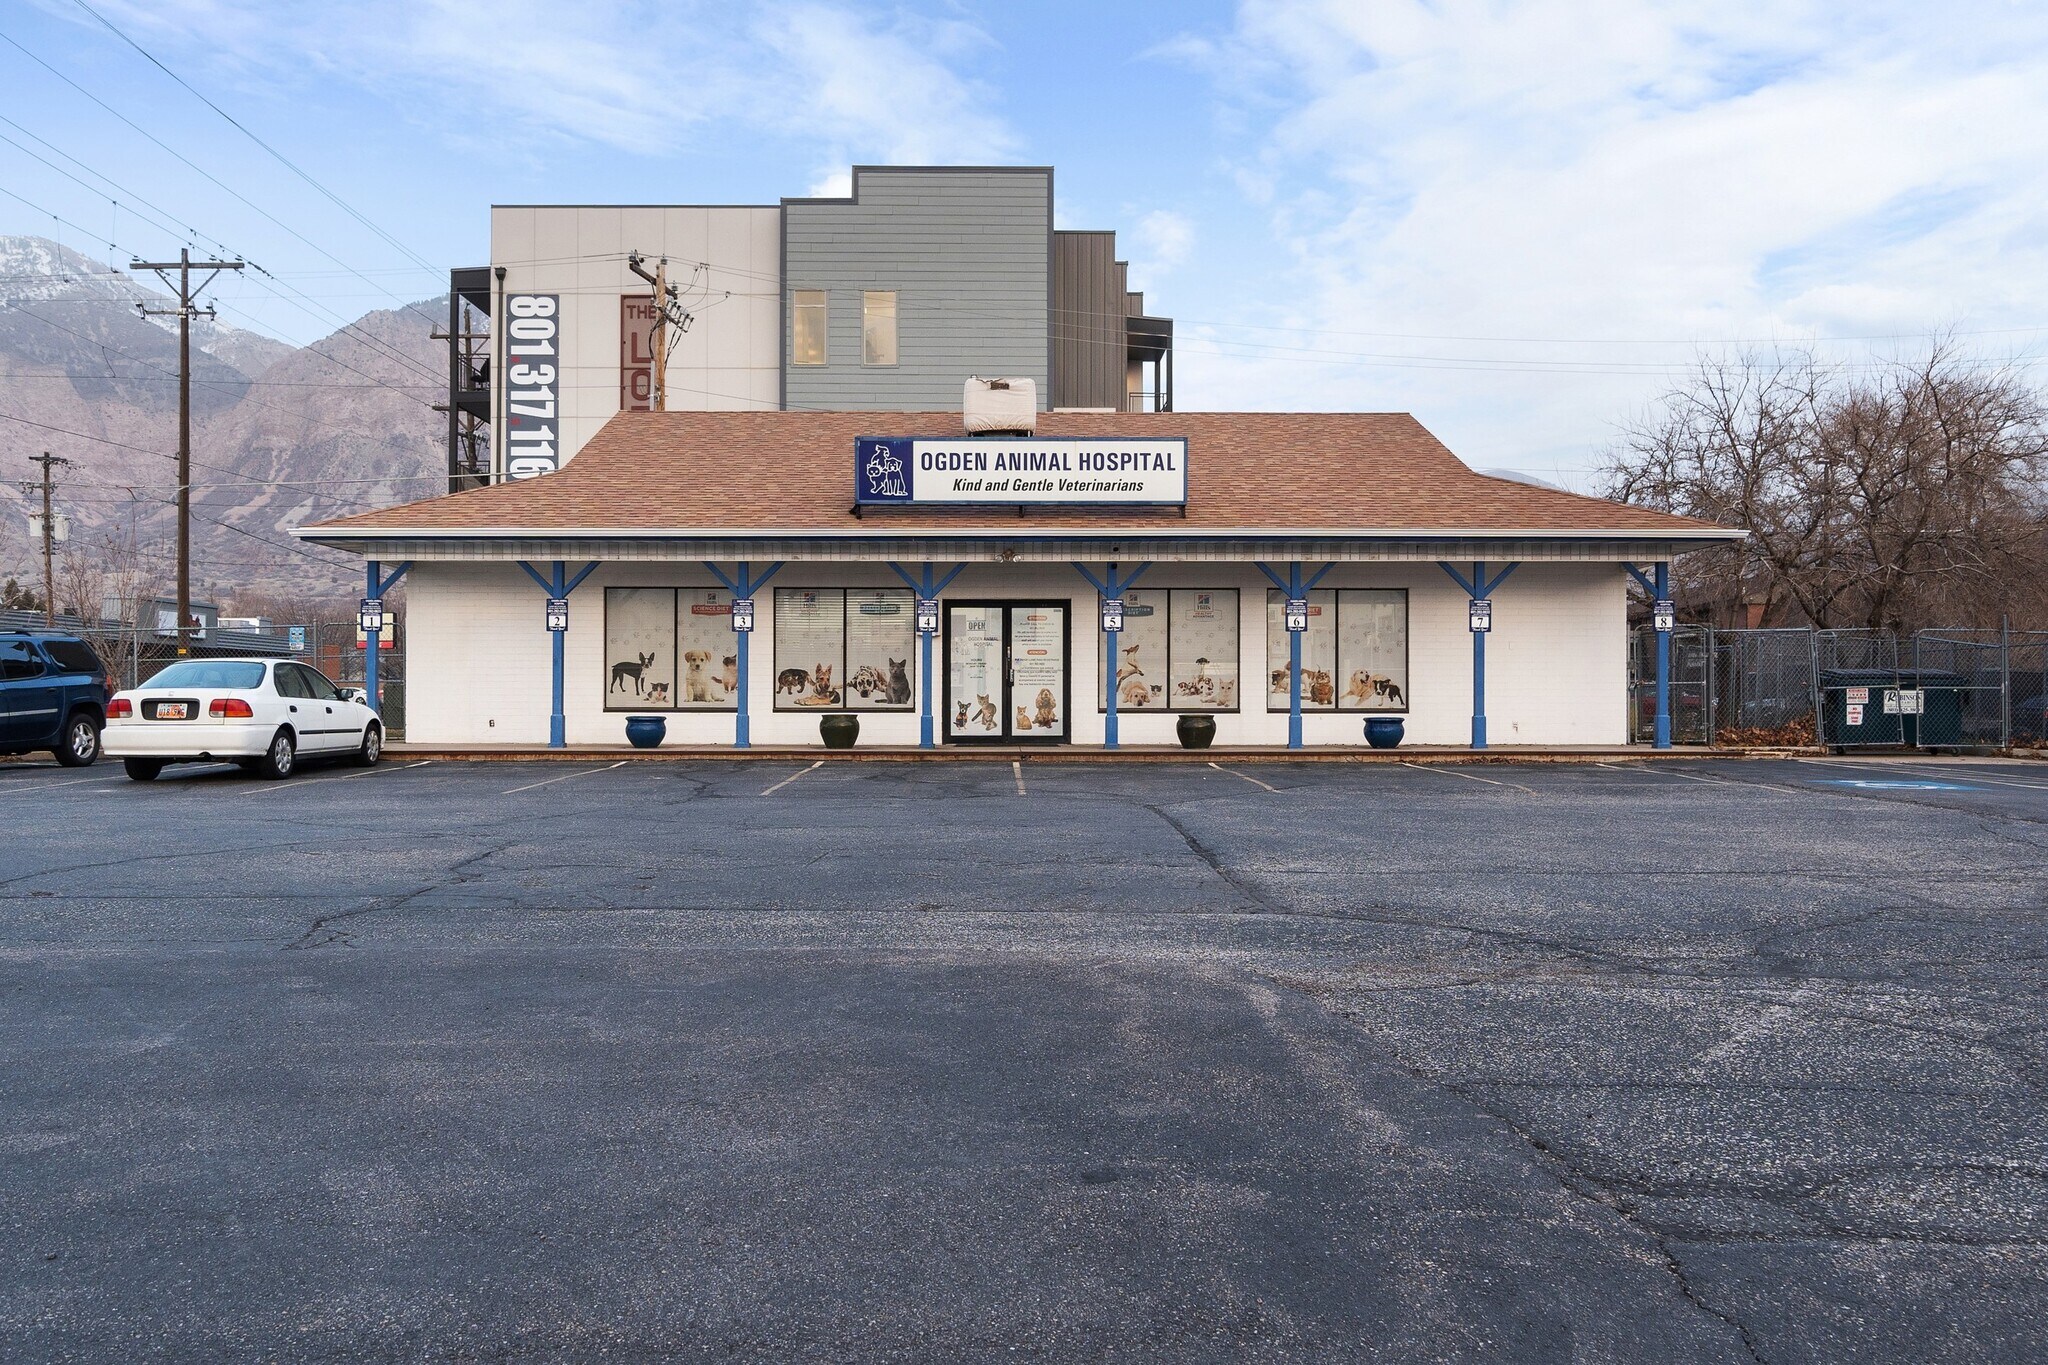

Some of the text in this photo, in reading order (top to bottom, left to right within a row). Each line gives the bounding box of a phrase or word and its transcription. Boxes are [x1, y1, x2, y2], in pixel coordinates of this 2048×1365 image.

[626, 305, 656, 319] THE
[920, 452, 1176, 472] OGDEN ANIMAL HOSPITAL
[952, 478, 1143, 492] Kind and Gentle Veterinarians
[369, 616, 374, 626] 1
[554, 616, 560, 626] 2
[739, 617, 746, 626] 3
[924, 617, 931, 627] 4
[968, 622, 986, 630] OPEN
[1109, 617, 1116, 627] 5
[1293, 617, 1300, 627] 6
[1477, 617, 1483, 627] 7
[1660, 617, 1667, 627] 8
